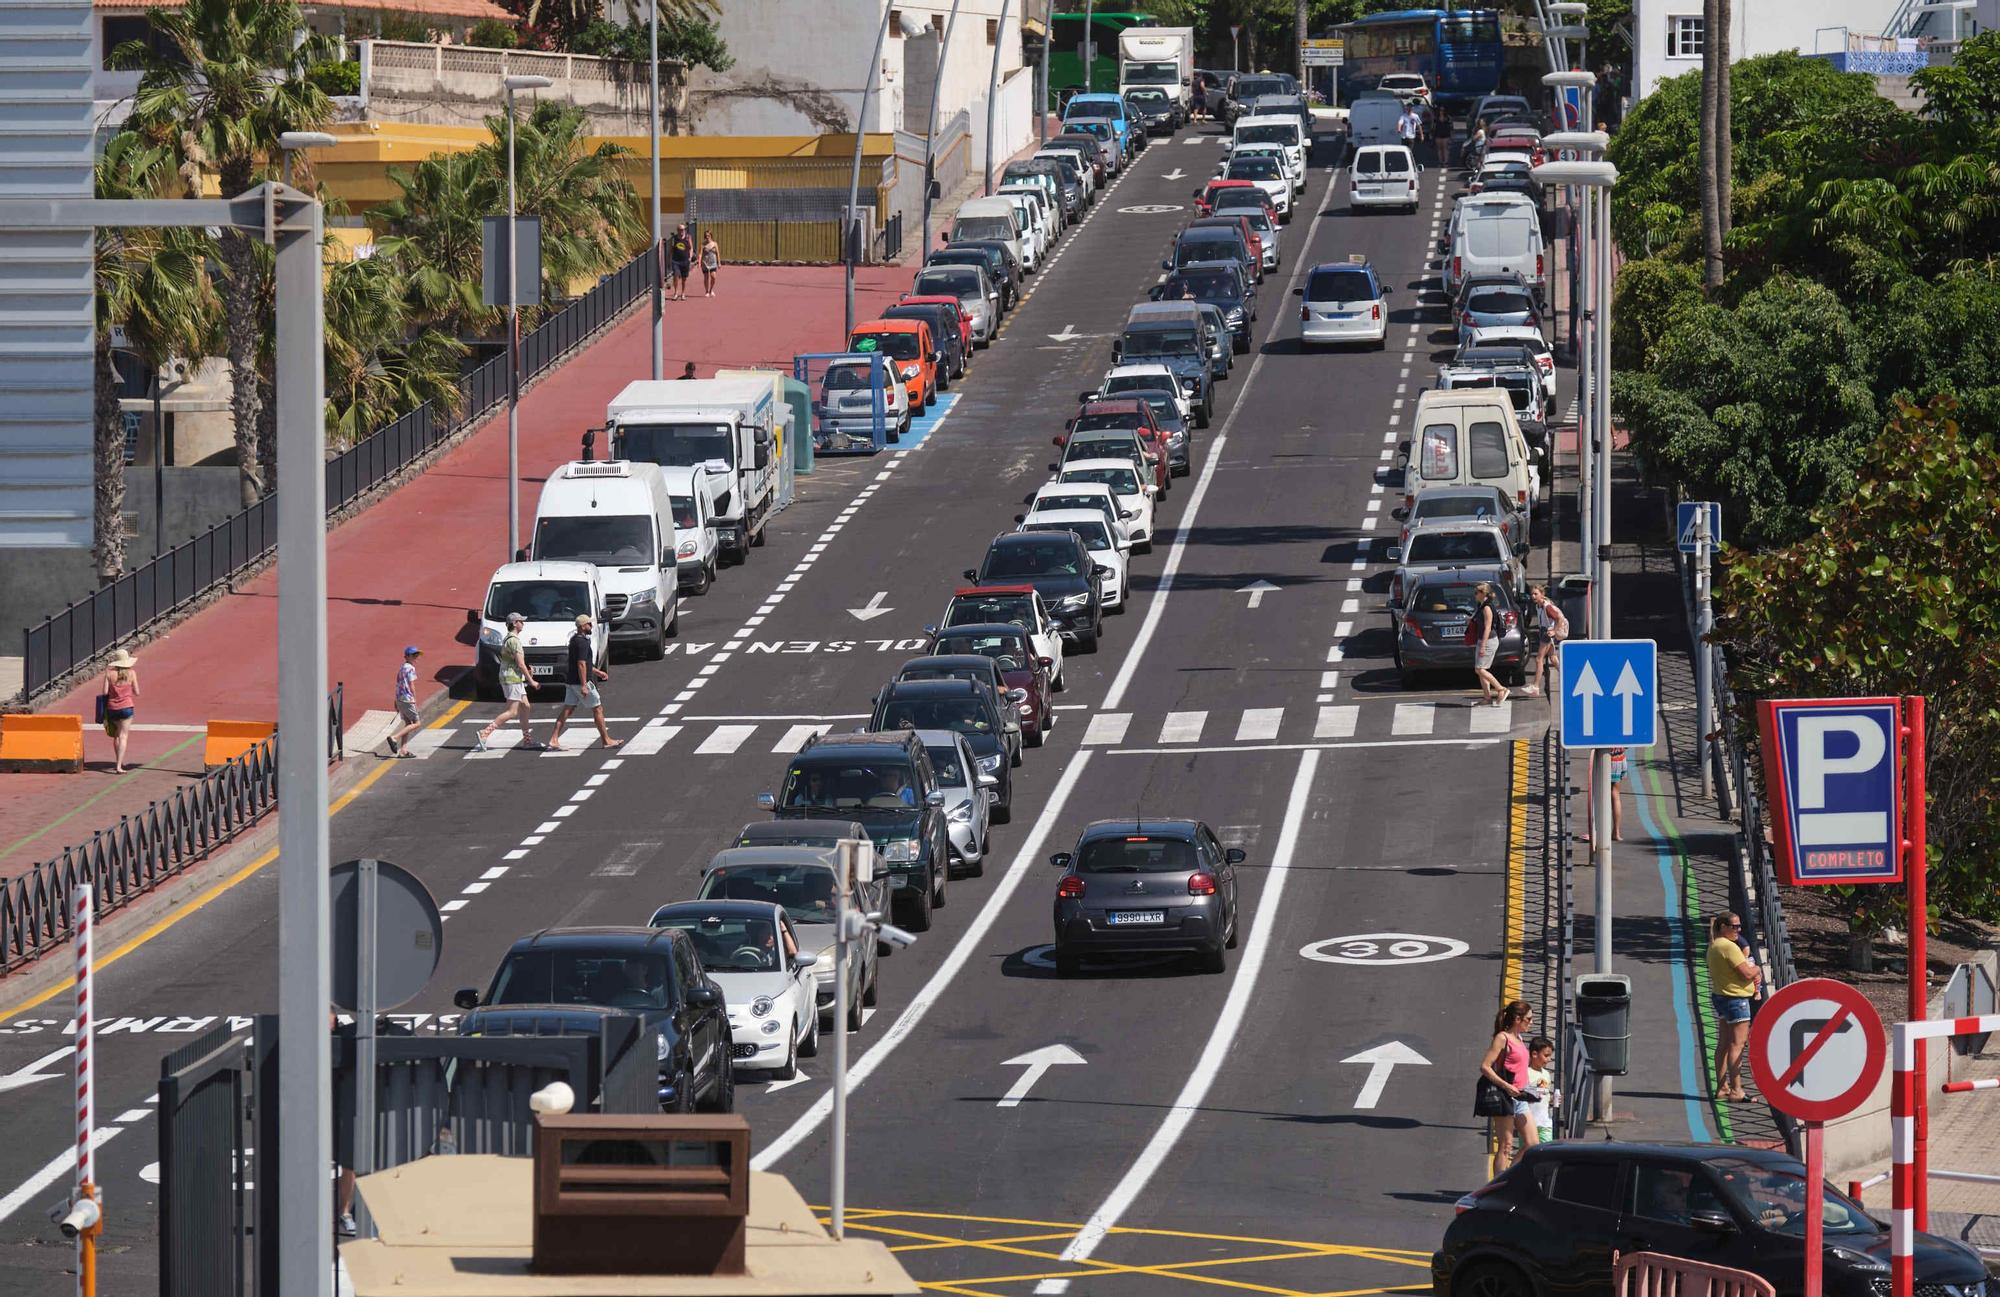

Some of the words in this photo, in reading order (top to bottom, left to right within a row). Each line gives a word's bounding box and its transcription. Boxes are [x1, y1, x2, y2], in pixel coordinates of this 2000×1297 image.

[1797, 714, 1886, 809] P
[1807, 851, 1885, 868] COMPLETO
[1117, 912, 1141, 923] 9990
[1143, 912, 1162, 922] LXR
[1340, 940, 1430, 958] 30
